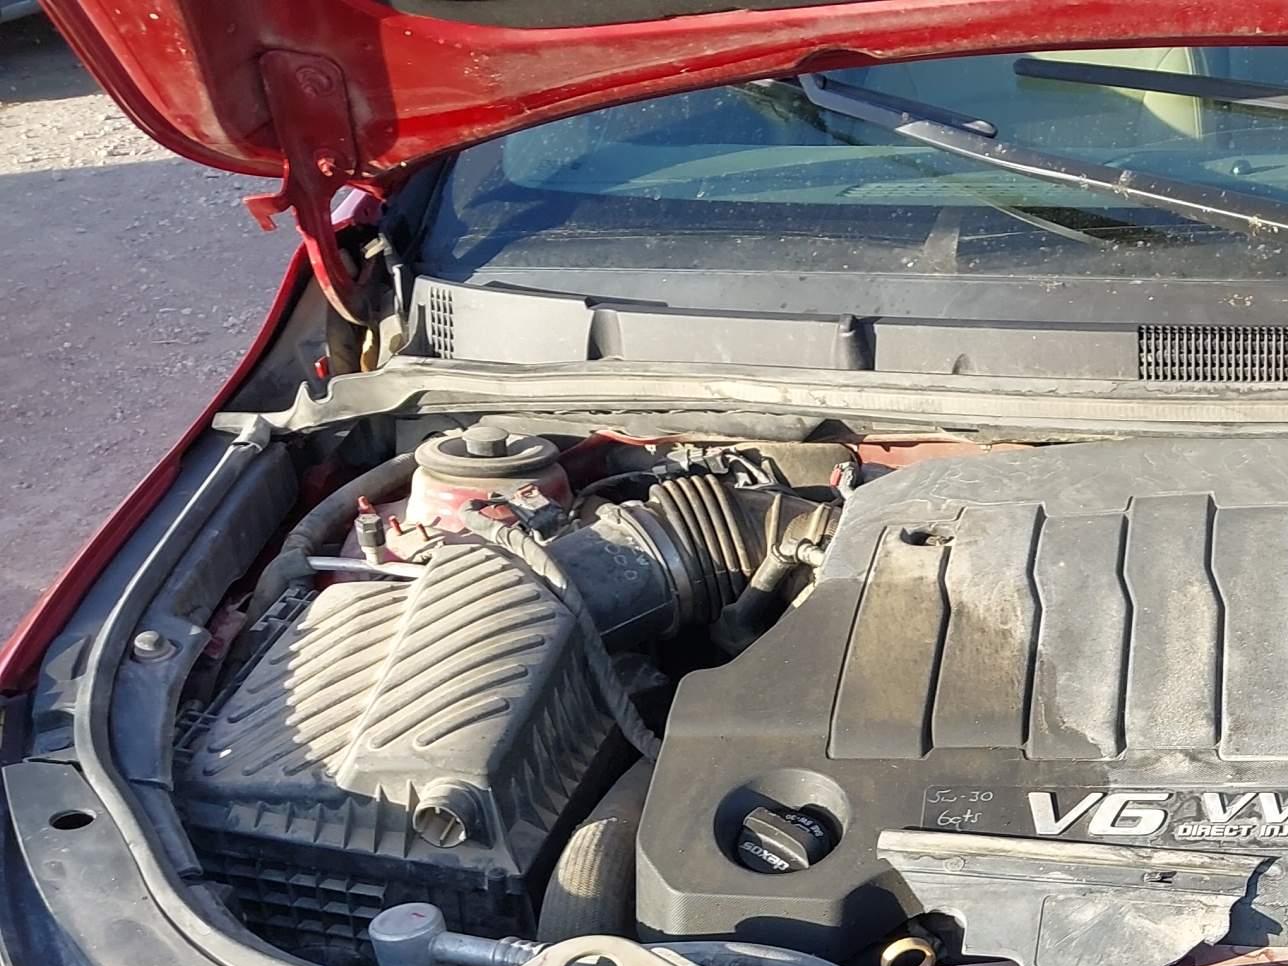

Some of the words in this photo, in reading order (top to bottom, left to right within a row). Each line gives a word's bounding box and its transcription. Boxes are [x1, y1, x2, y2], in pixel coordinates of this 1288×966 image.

[1027, 791, 1174, 837] V6
[1177, 823, 1254, 839] DIRECT
[739, 840, 790, 871] dexos
